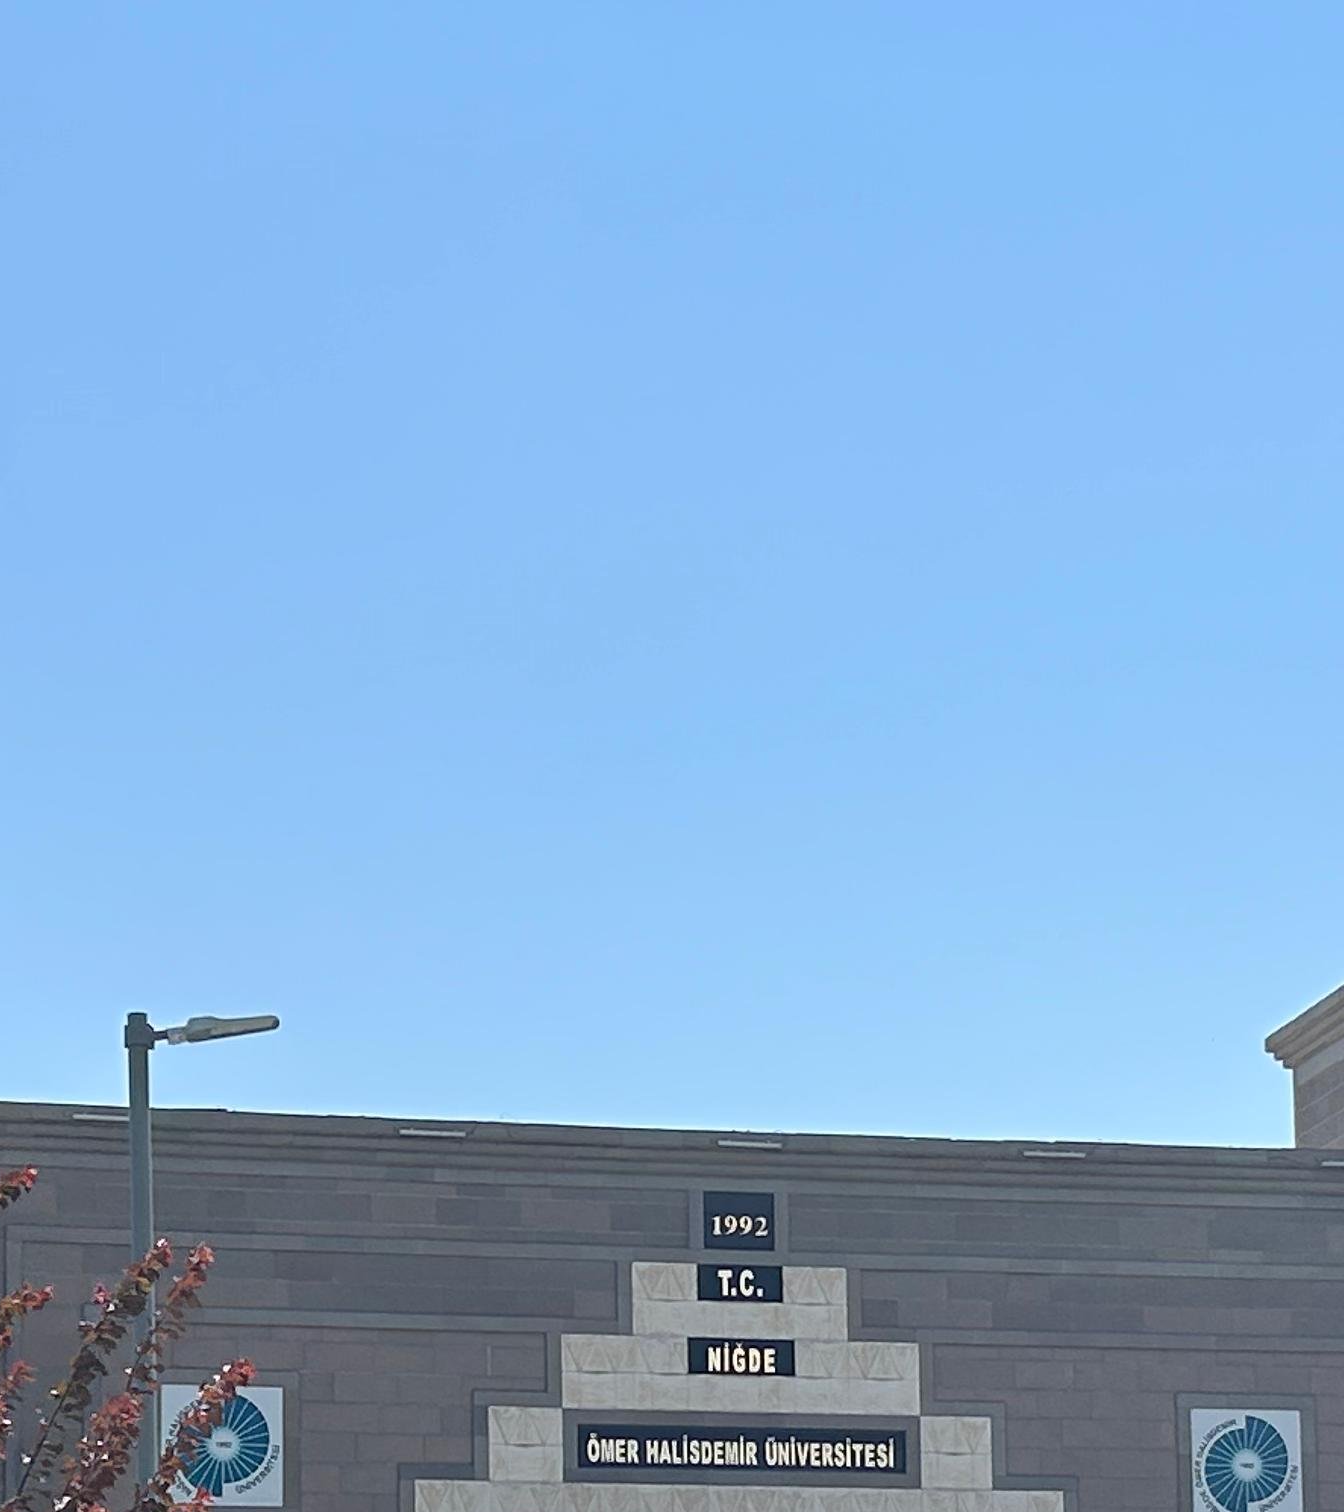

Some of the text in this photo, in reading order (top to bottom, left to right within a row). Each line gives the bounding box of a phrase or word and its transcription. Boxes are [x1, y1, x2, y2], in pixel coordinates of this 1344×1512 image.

[712, 1215, 769, 1237] 1992
[717, 1269, 764, 1297] T.C.
[707, 1342, 776, 1374] NİĞDE
[587, 1432, 895, 1468] ÖMER HALİSDEMİR ÜNİVERSİTESİ
